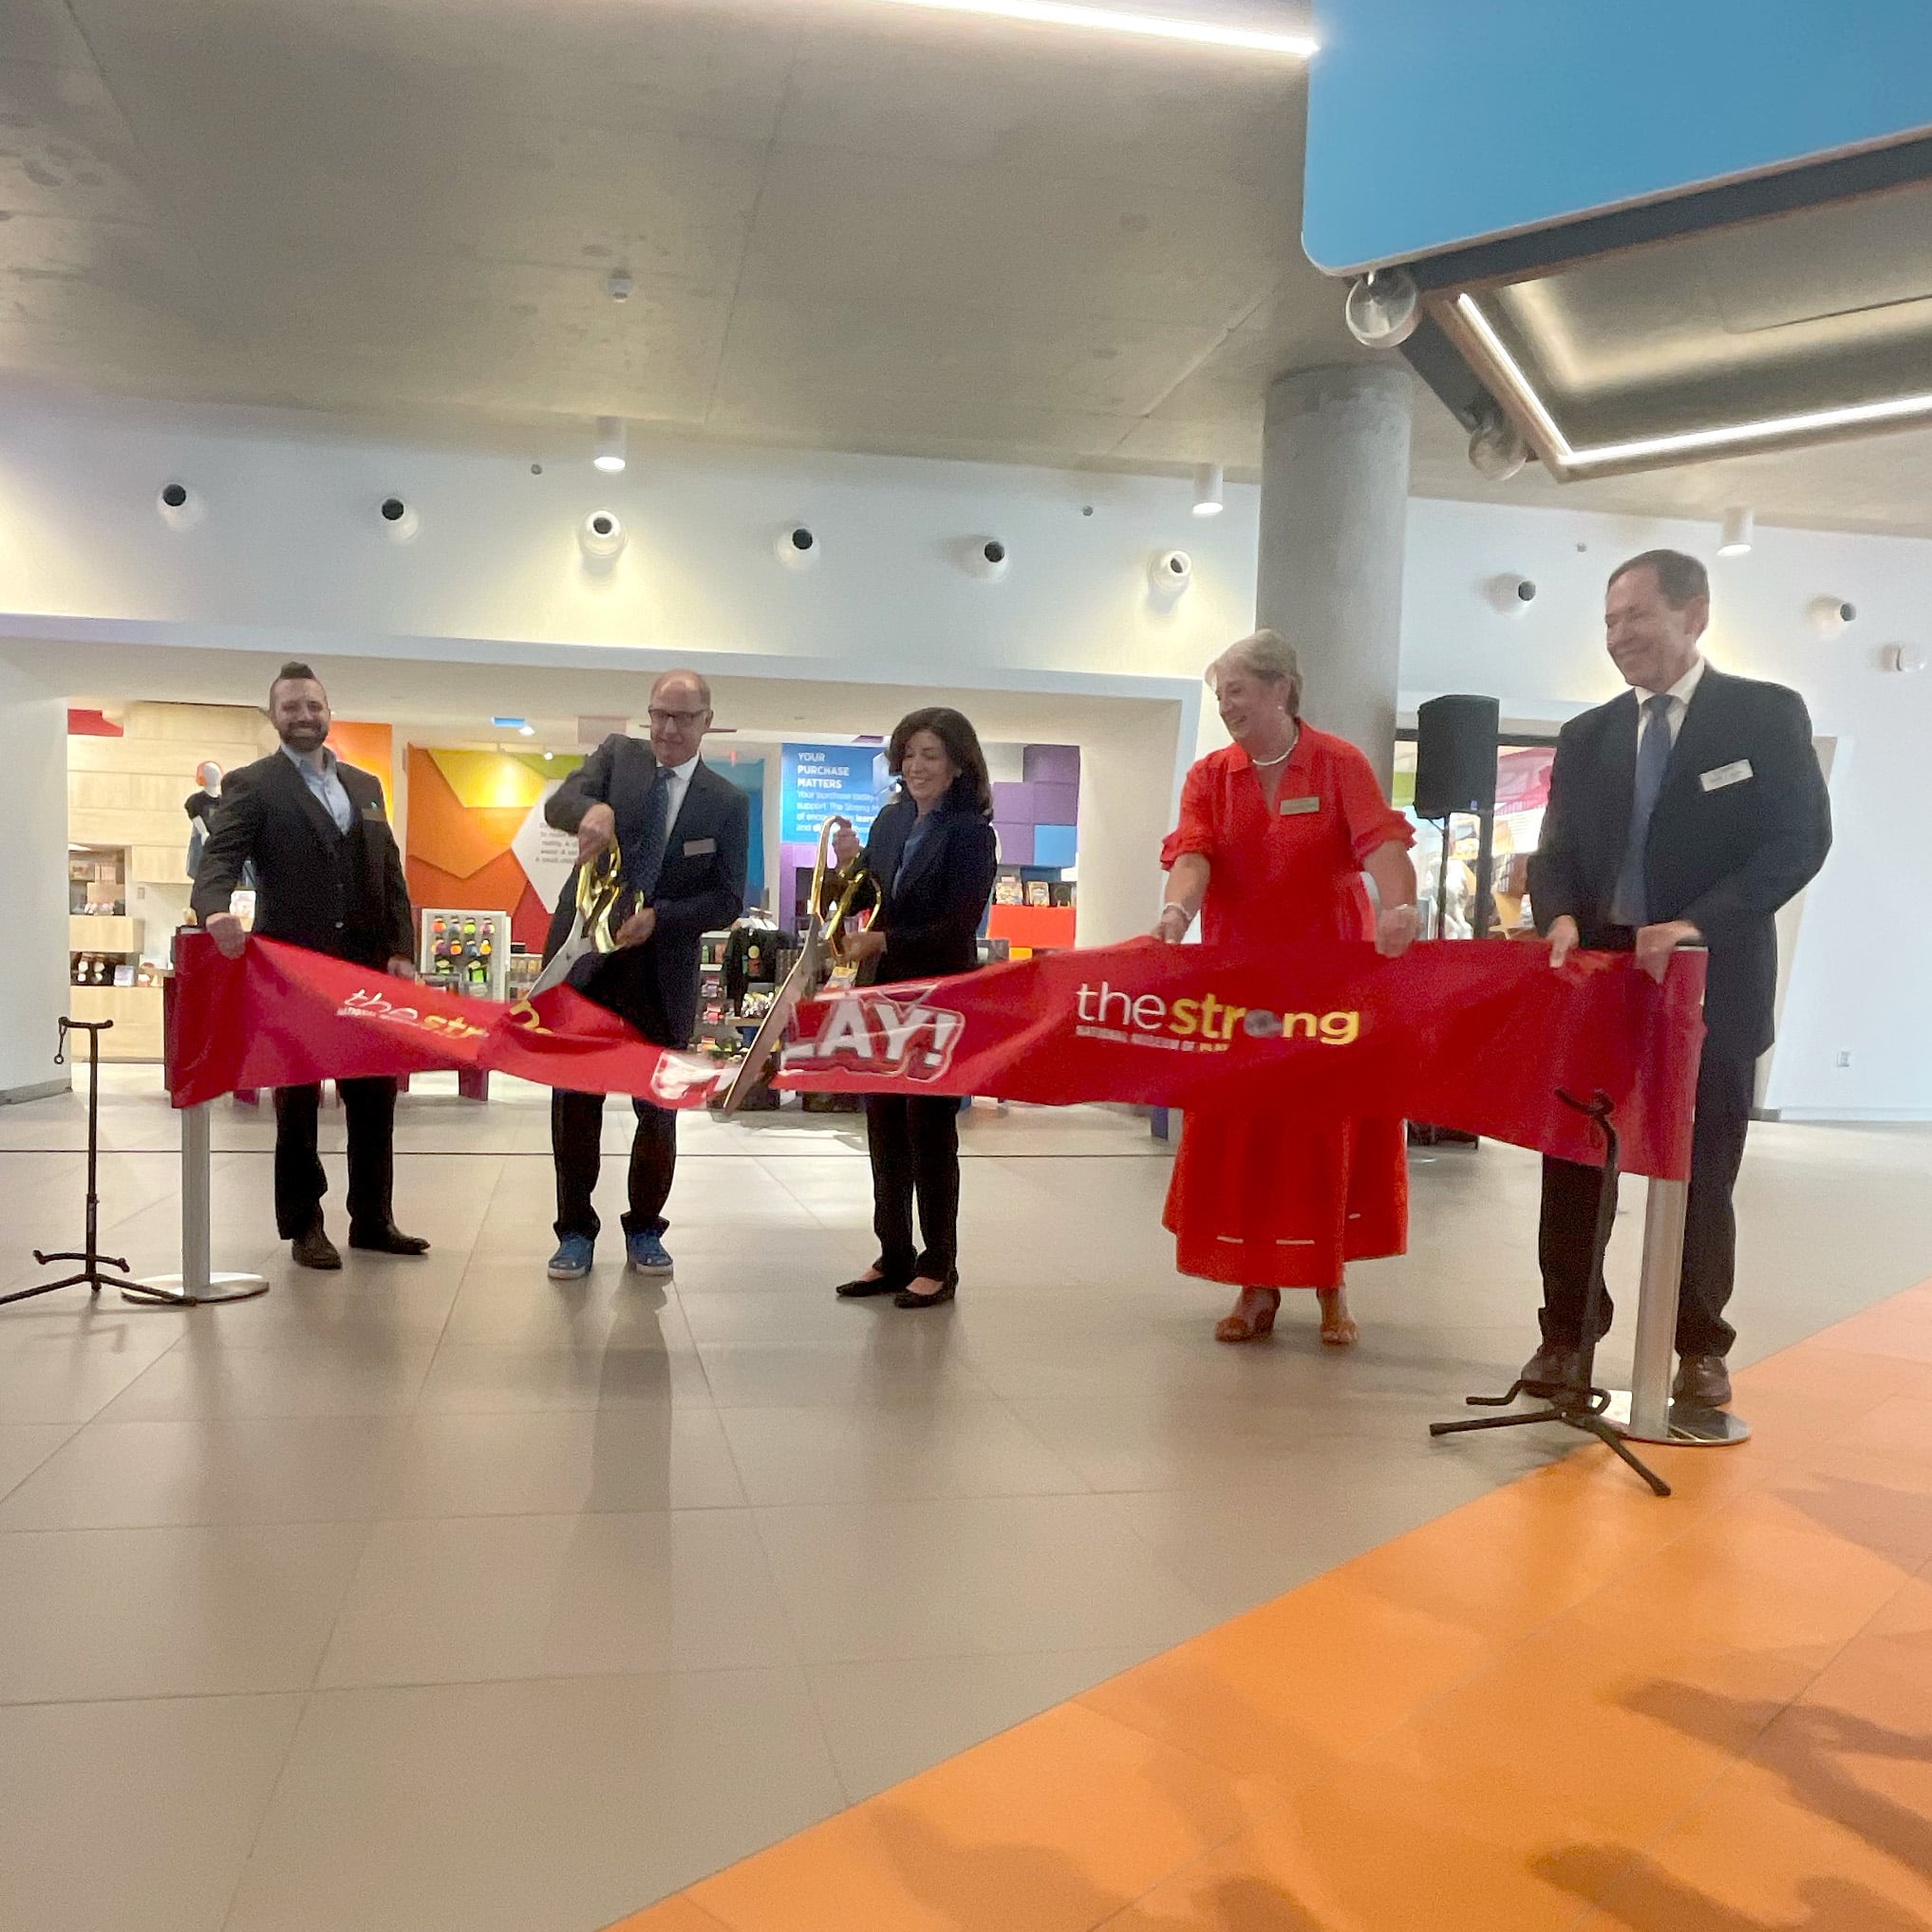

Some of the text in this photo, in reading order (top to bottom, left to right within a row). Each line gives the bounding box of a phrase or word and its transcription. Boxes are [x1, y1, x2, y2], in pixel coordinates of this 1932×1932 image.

[797, 752, 826, 762] YOUR
[797, 764, 851, 777] PURCHASE
[797, 778, 842, 789] MATTERS
